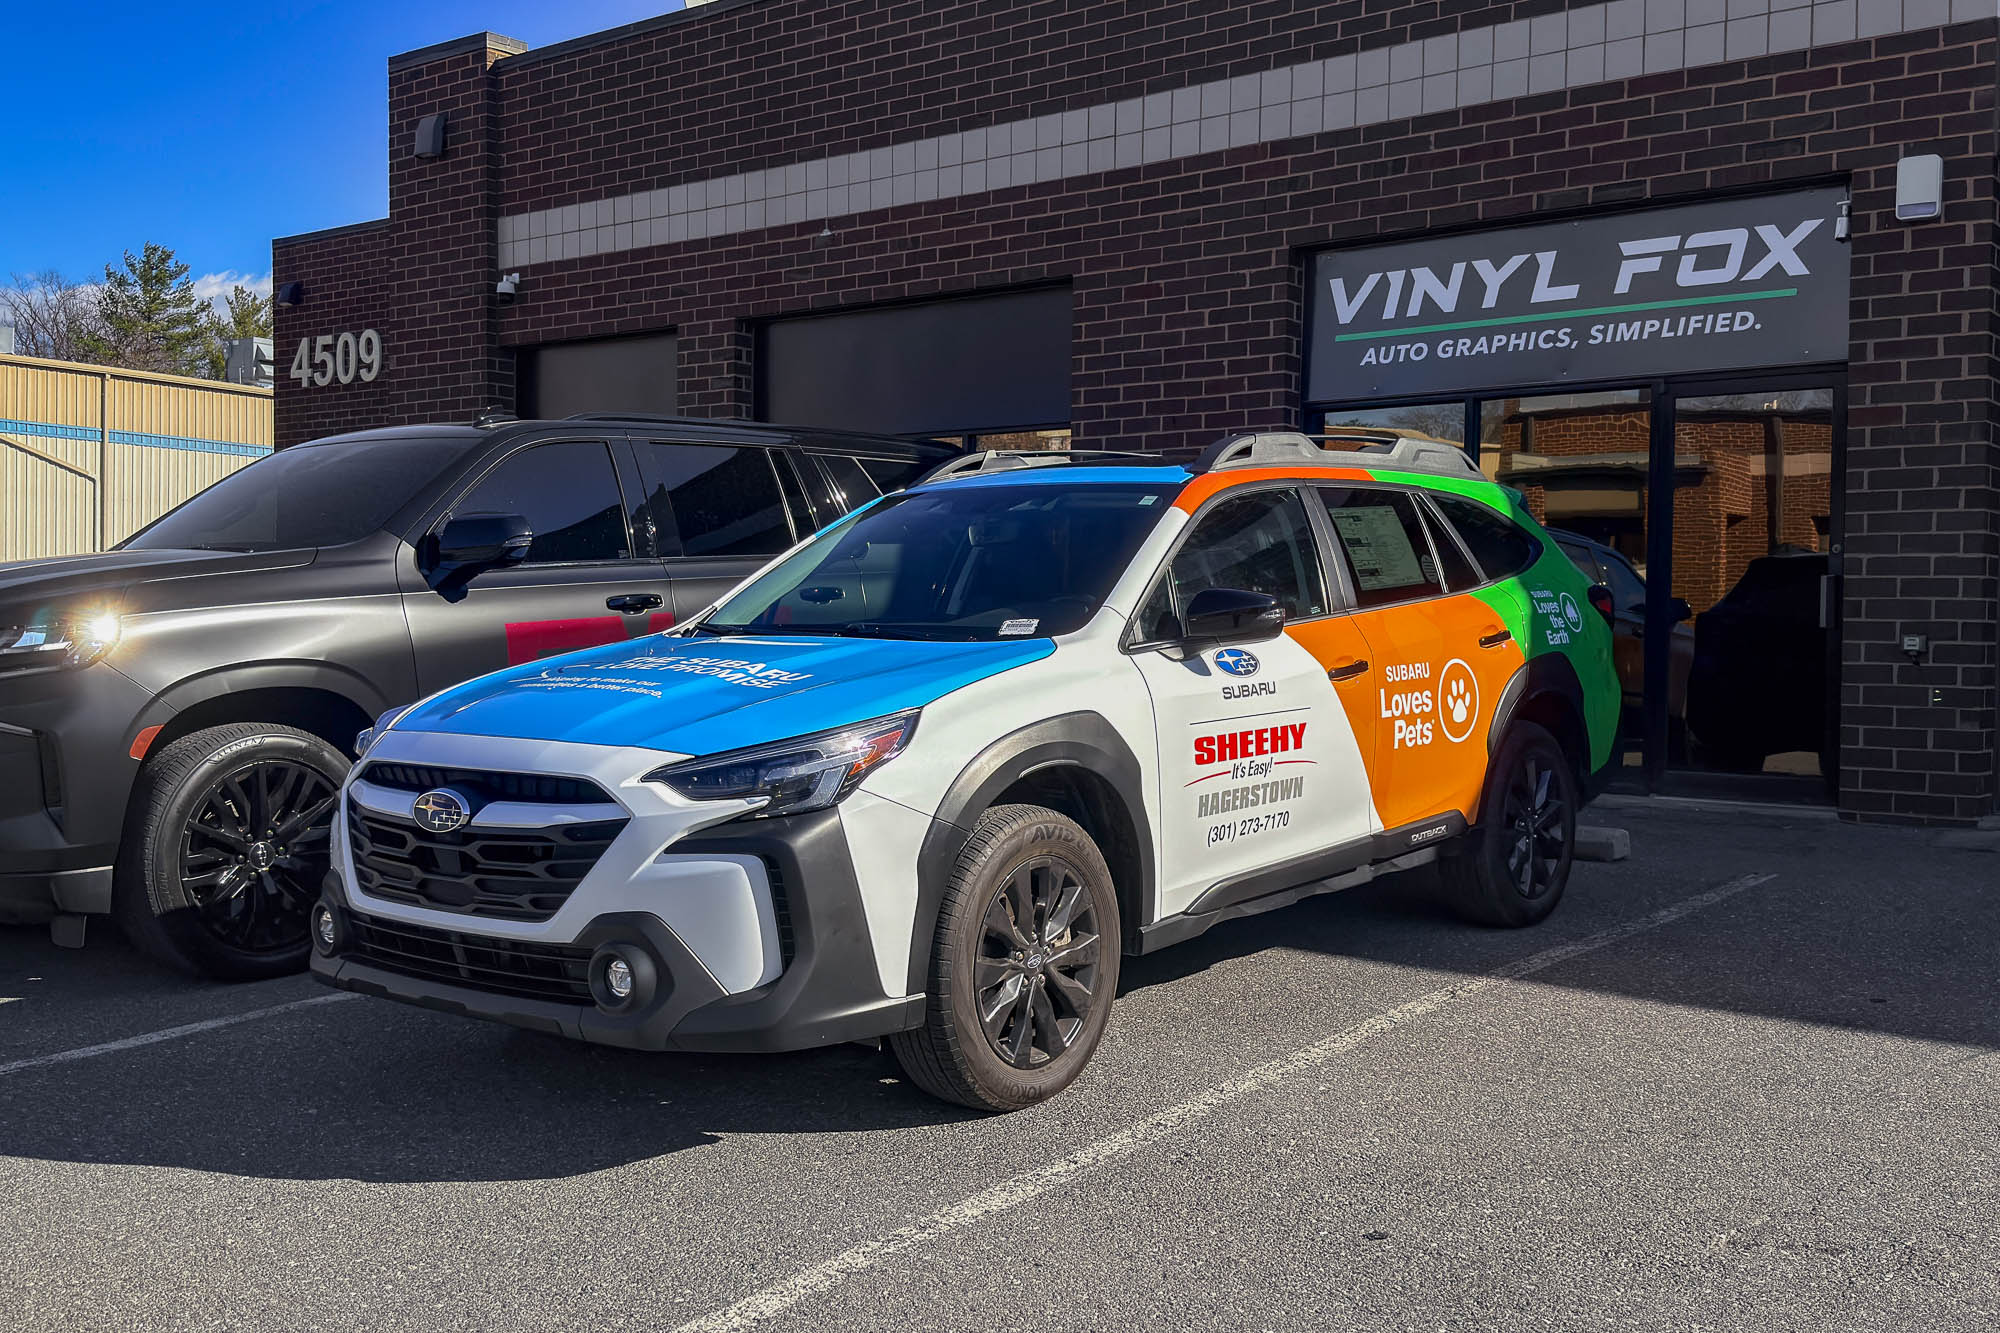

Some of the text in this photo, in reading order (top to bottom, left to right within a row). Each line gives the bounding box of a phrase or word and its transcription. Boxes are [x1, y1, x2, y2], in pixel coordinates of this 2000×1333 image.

[1329, 218, 1825, 325] VINYL FOX
[1360, 311, 1762, 366] AUTO GRAPHICS, SIMPLIFIED.
[290, 328, 382, 388] 4509
[1532, 599, 1560, 614] Loves
[1549, 614, 1566, 629] the
[1545, 629, 1570, 645] Earth
[657, 663, 789, 689] PROMISE
[680, 657, 814, 683] SUBARU
[1385, 662, 1431, 683] SUBARU
[1222, 681, 1277, 700] SUBARU
[1379, 687, 1433, 719] Loves
[1194, 722, 1307, 766] SHEEHY
[1393, 719, 1433, 750] Pets
[1231, 757, 1273, 780] It's Easy!
[1197, 776, 1304, 818] HAGERSTOWN
[1207, 810, 1290, 847] (301) 273-7170
[1411, 825, 1447, 842] OUTBACK
